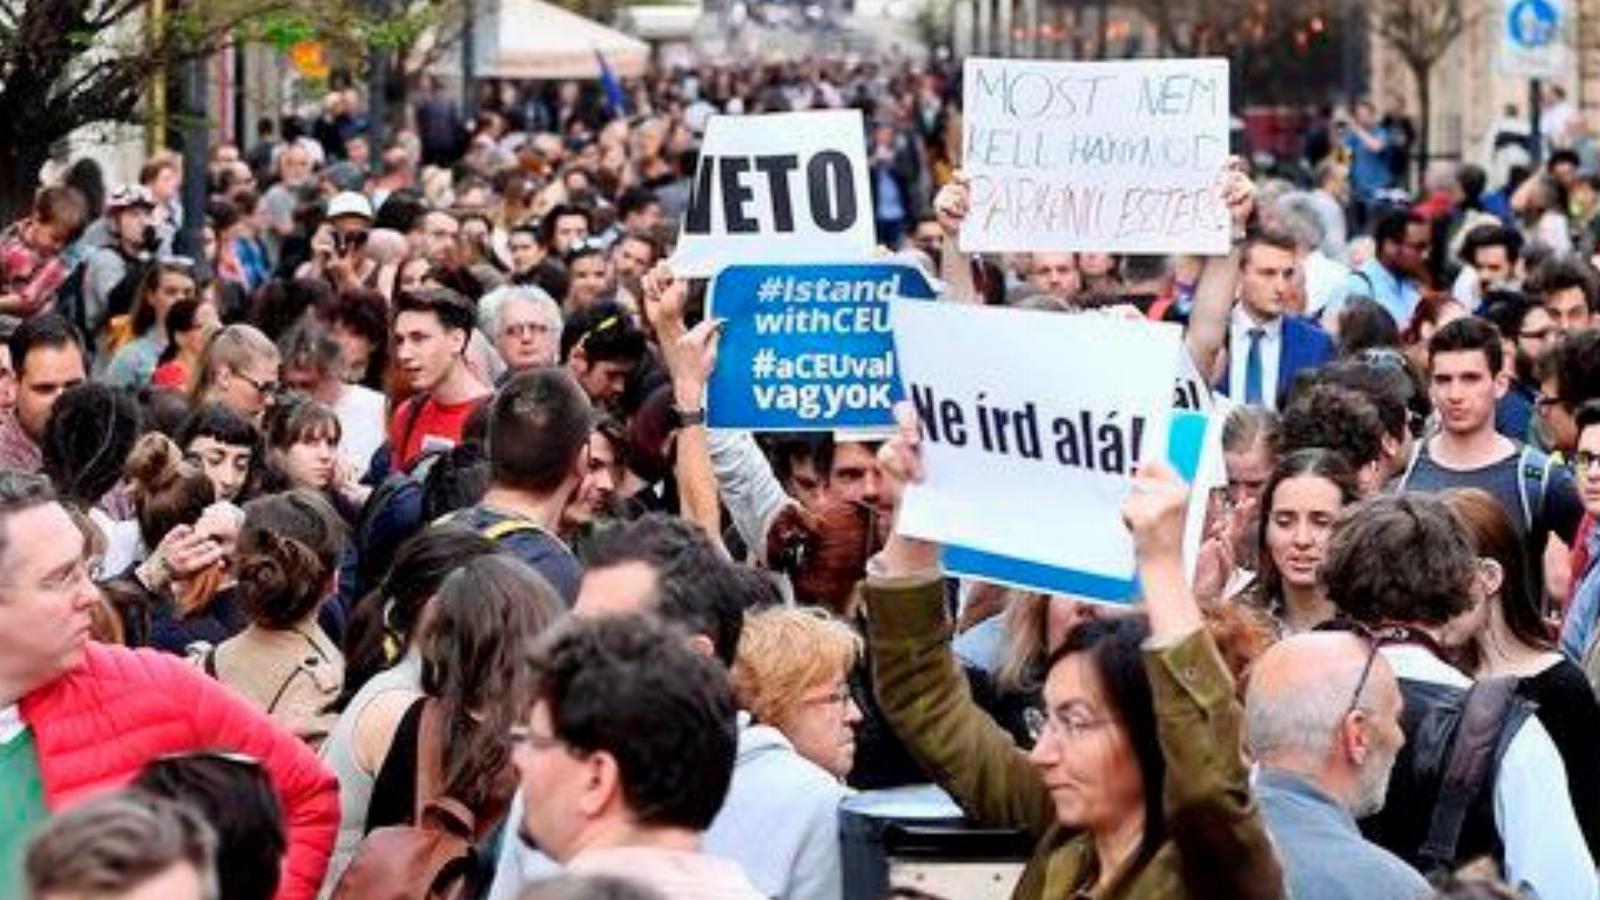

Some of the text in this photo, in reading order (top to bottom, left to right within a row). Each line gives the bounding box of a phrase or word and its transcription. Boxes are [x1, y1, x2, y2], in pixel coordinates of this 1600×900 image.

[976, 67, 1217, 119] MOST NEM
[969, 124, 1051, 168] KELL
[685, 149, 857, 234] VETO
[757, 275, 900, 302] #Istand
[755, 307, 892, 334] withCEU
[752, 348, 894, 378] #aCEUval
[752, 383, 891, 419] vagyok
[910, 383, 1145, 476] Ne írd alá!
